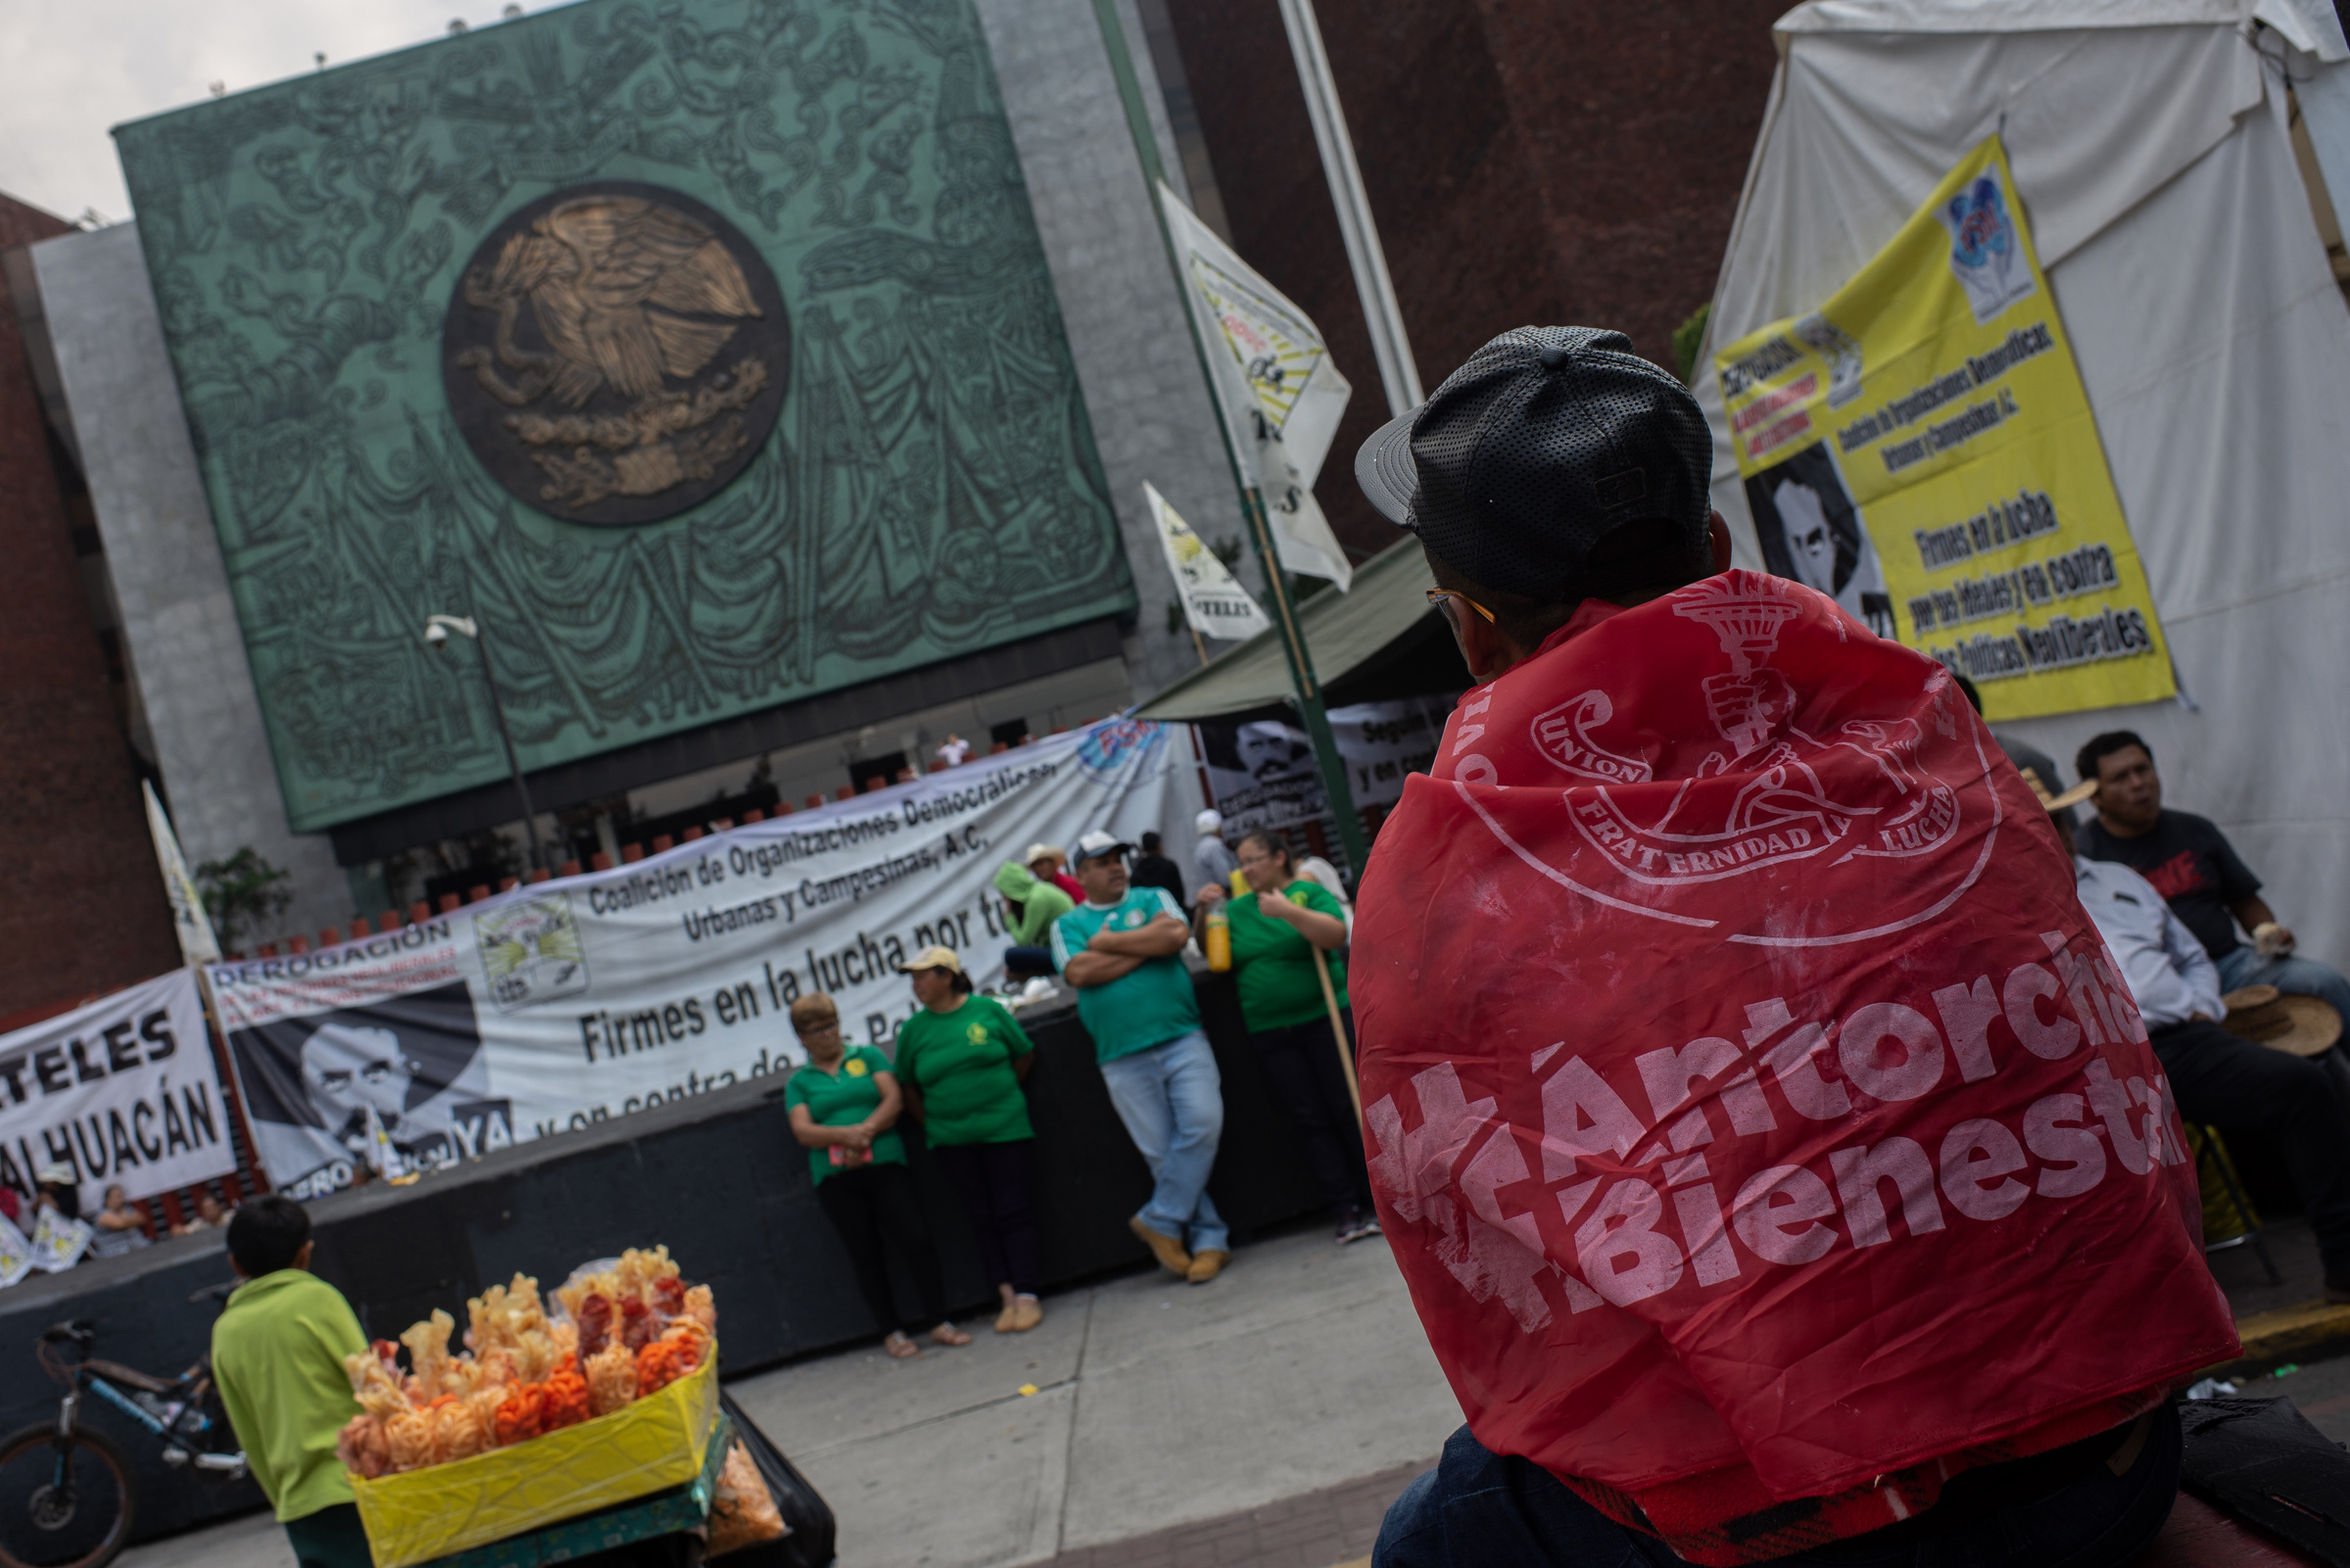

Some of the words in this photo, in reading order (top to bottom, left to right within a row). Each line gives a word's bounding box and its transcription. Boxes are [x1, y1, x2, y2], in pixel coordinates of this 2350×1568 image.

[2045, 542, 2121, 601] contra
[1539, 716, 1643, 783] UNION
[1575, 799, 1812, 875] FRATERNIDAD
[1878, 785, 1954, 853] LUCHA
[591, 863, 693, 916] Coalición
[697, 854, 725, 887] de
[730, 812, 898, 878] Organizaciones
[683, 898, 778, 940] Urbanas
[780, 889, 795, 923] y
[578, 992, 705, 1065] Firmes
[714, 979, 760, 1027] en
[762, 960, 801, 1009] la
[806, 930, 908, 993] lucha
[0, 1008, 176, 1109] TELES
[453, 1107, 514, 1159] YA
